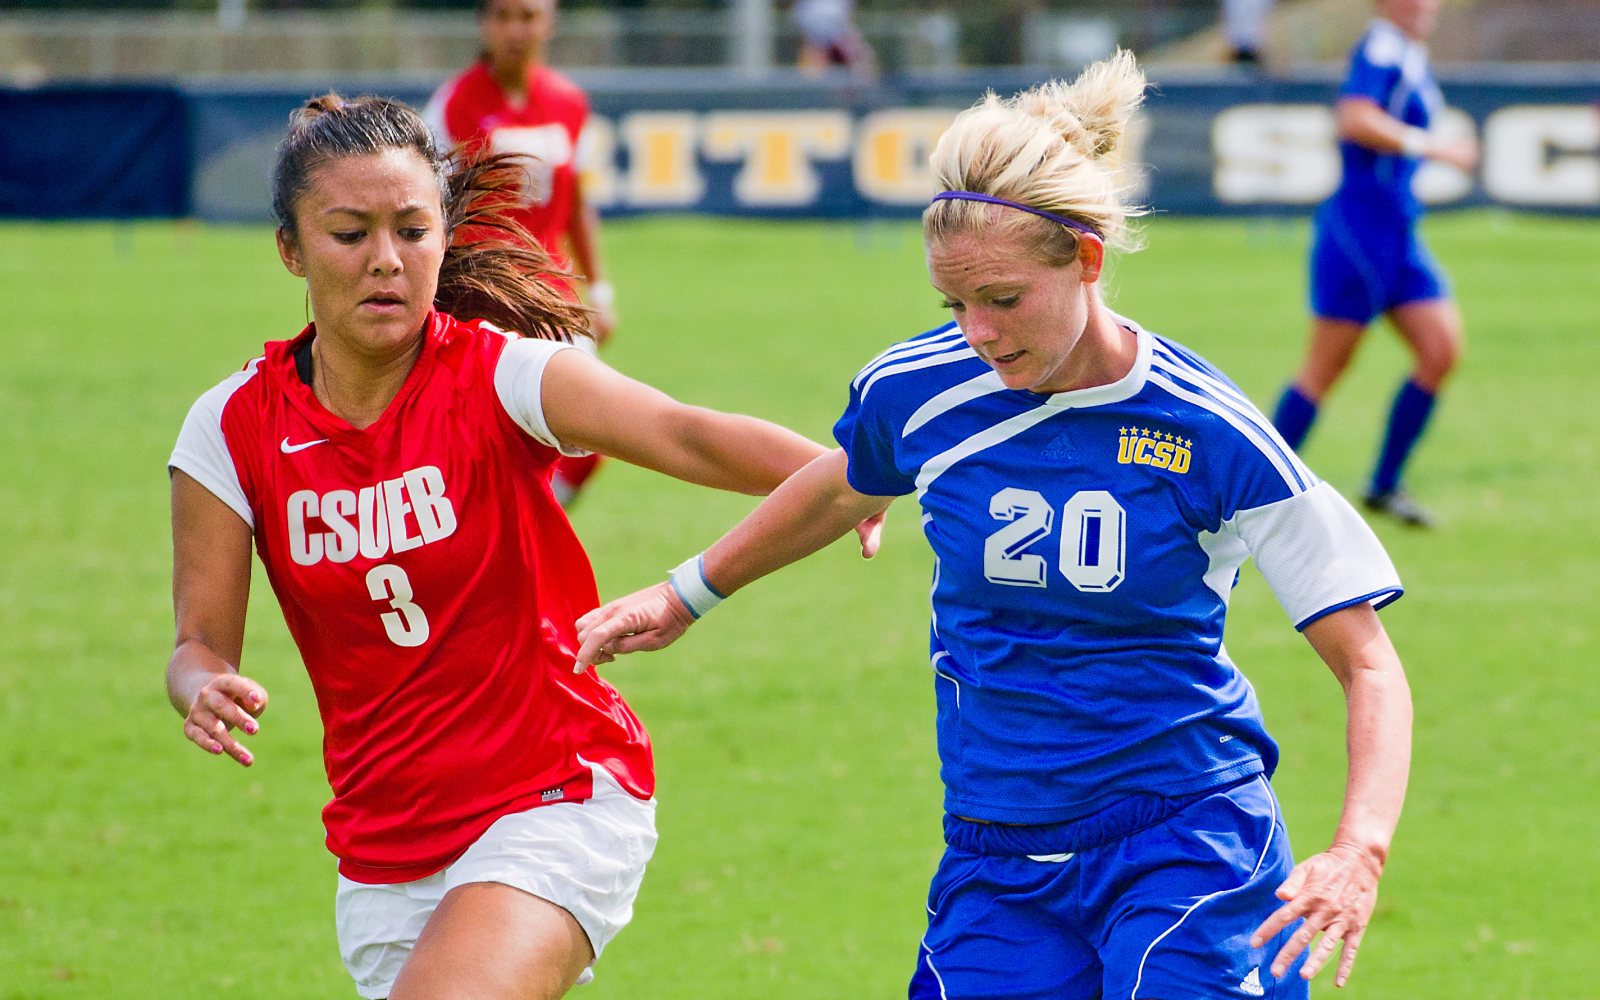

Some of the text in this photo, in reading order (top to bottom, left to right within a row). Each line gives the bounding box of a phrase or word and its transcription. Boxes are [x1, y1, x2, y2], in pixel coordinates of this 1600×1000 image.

[1117, 435, 1192, 474] UCSD
[287, 465, 457, 566] CSUEB
[983, 486, 1127, 593] 20
[365, 563, 430, 647] 3
